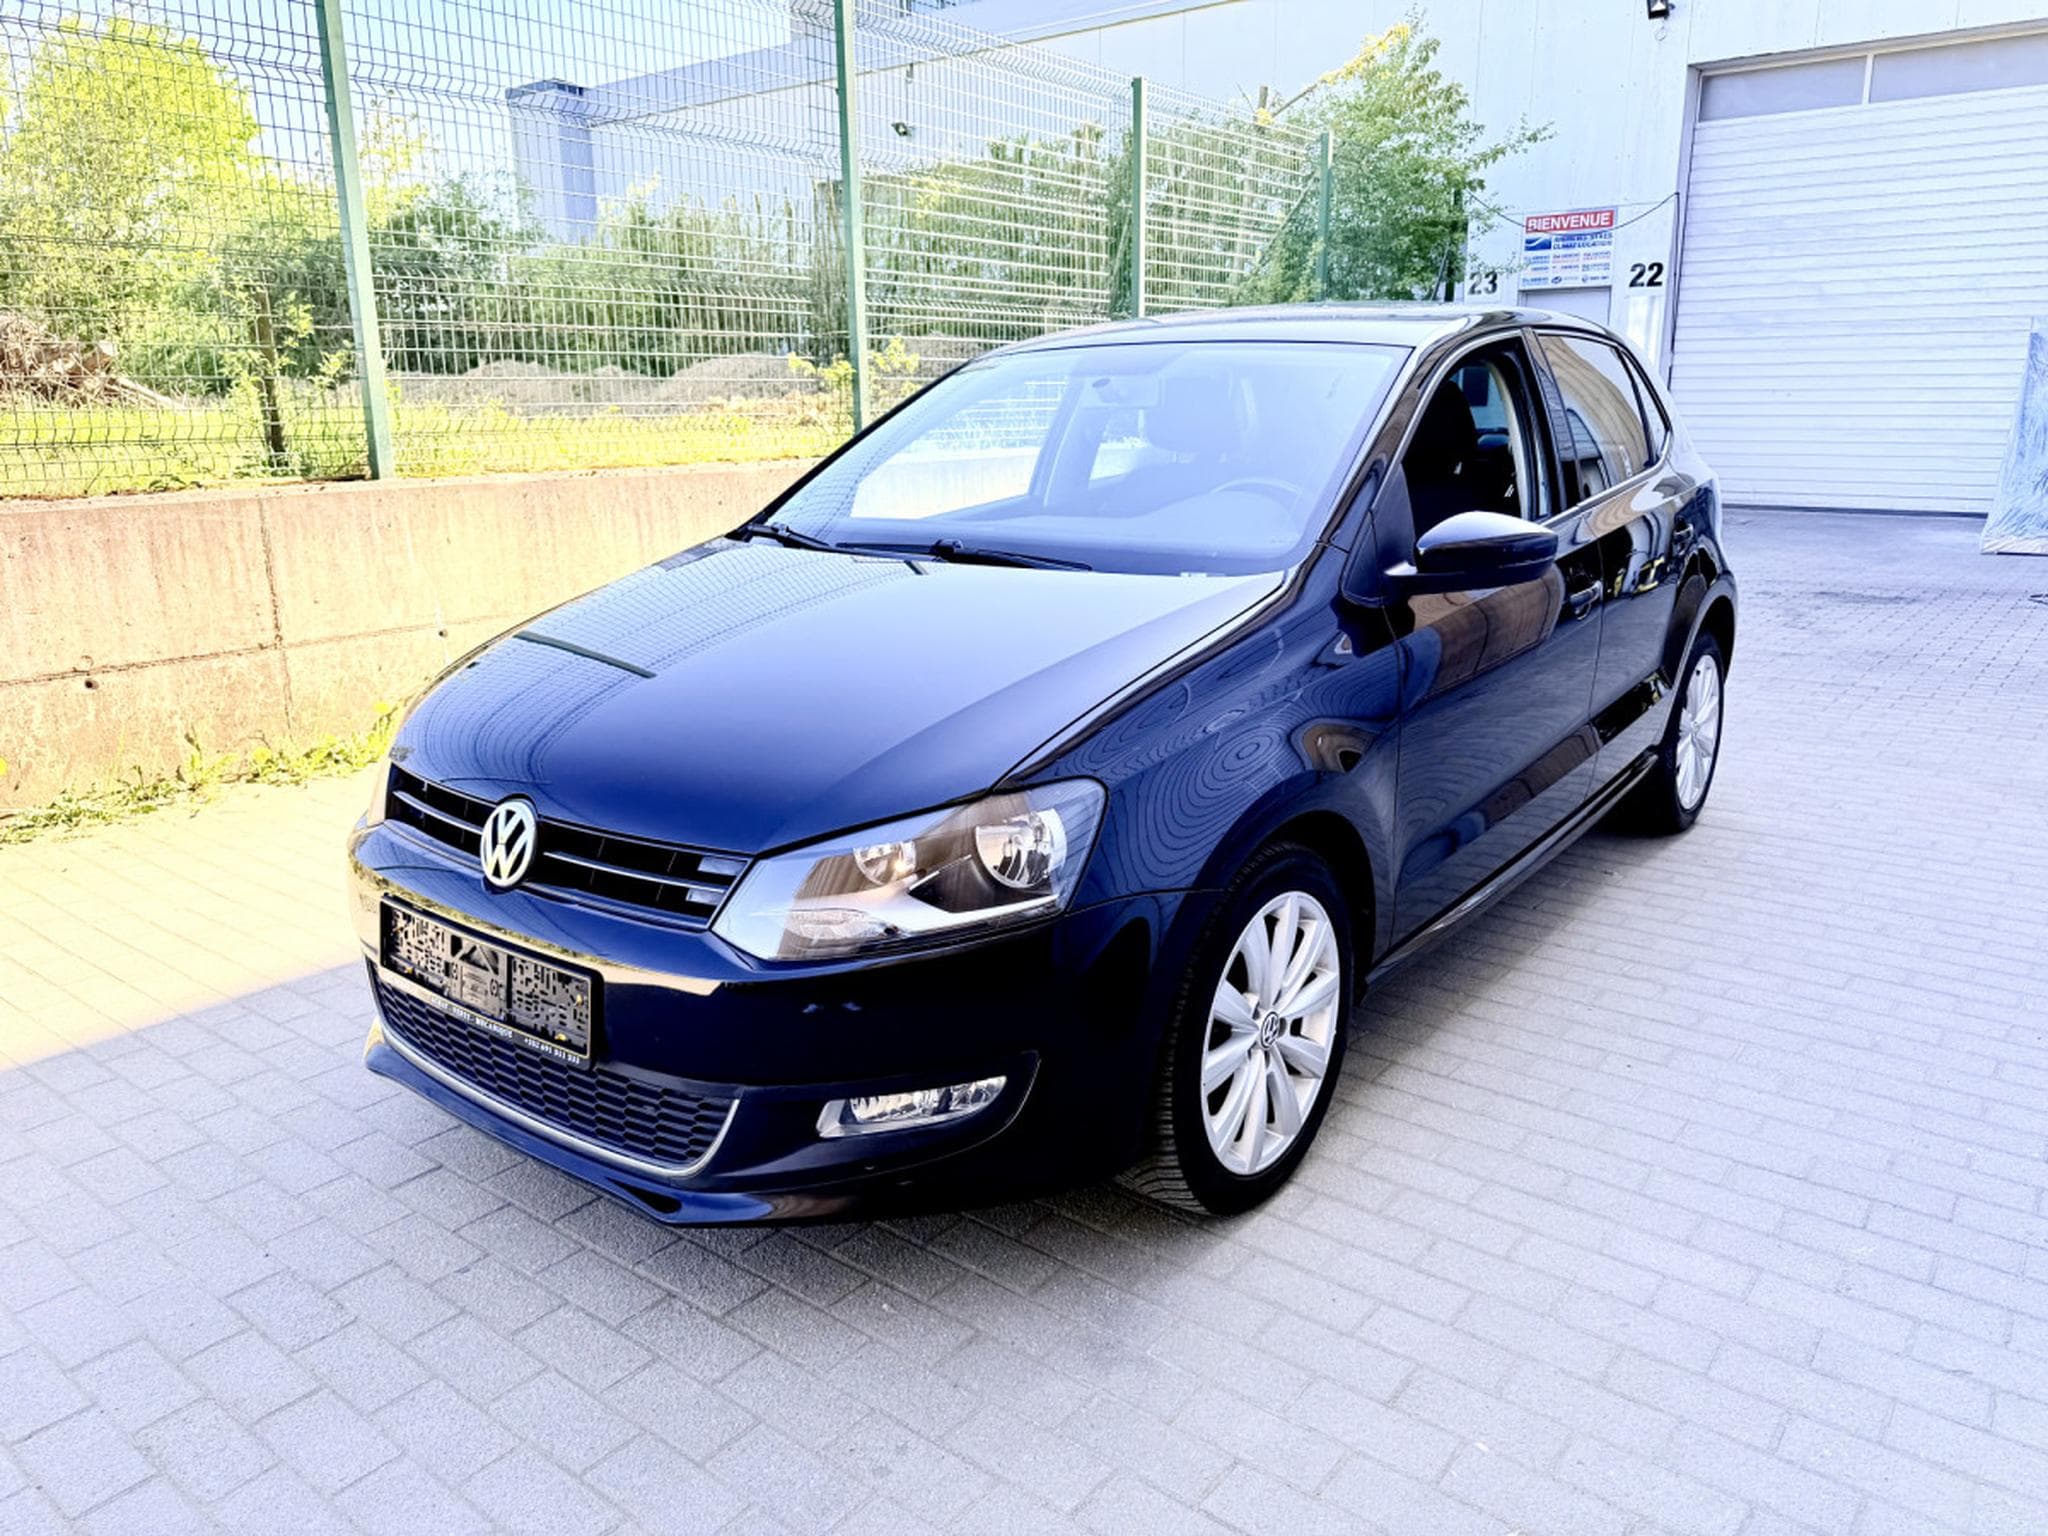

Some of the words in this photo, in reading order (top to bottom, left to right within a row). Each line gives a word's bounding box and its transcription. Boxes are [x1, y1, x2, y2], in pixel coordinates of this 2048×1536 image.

[1526, 212, 1612, 232] BIENVENUE
[1468, 270, 1498, 295] 23
[1629, 262, 1664, 287] 22
[481, 800, 537, 887] VW
